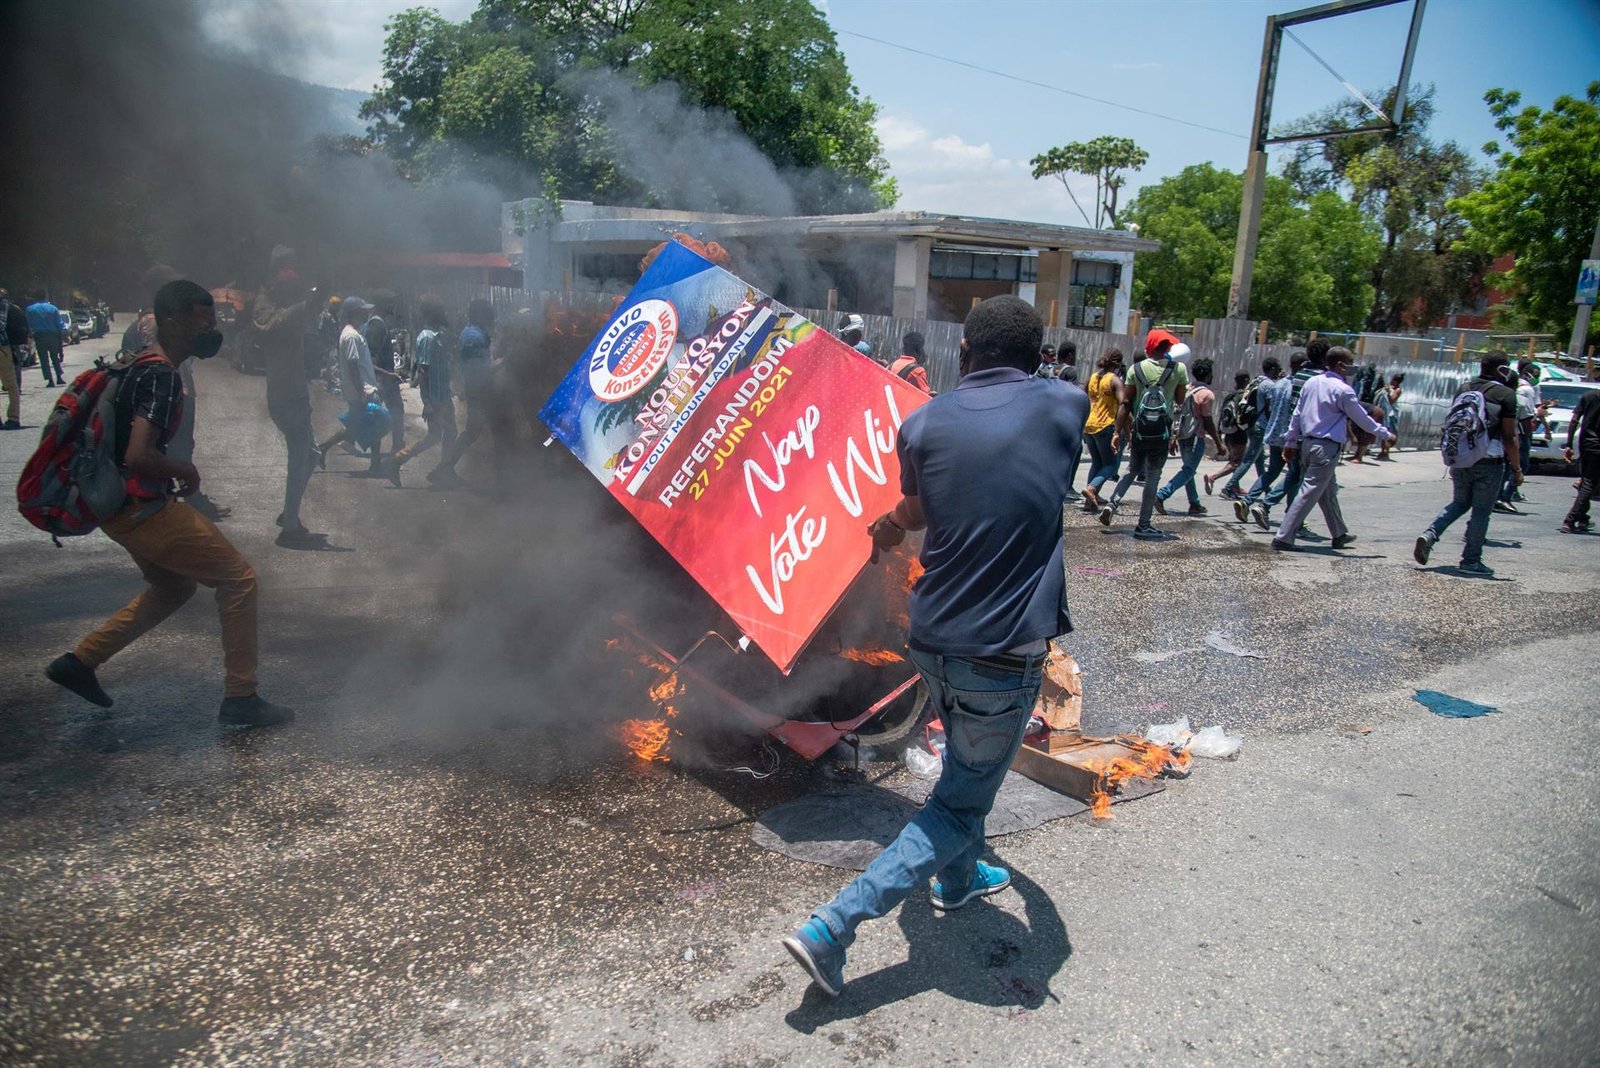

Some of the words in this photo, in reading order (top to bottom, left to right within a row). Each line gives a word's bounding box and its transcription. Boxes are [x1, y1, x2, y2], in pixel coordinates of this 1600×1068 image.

[591, 308, 642, 373] NOUVO
[603, 310, 674, 395] Konstitisyon
[614, 299, 756, 485] KONSTITISYON
[634, 337, 707, 428] NOUVO
[641, 434, 672, 473] TOUT
[671, 390, 706, 434] MOUN
[705, 340, 746, 388] LADAN
[744, 330, 755, 341] L
[659, 335, 794, 508] REFERANDÒM
[688, 468, 710, 501] 27
[713, 416, 753, 471] JUIN
[750, 365, 793, 417] 2021
[743, 404, 820, 518] Nap
[746, 505, 827, 614] Vote
